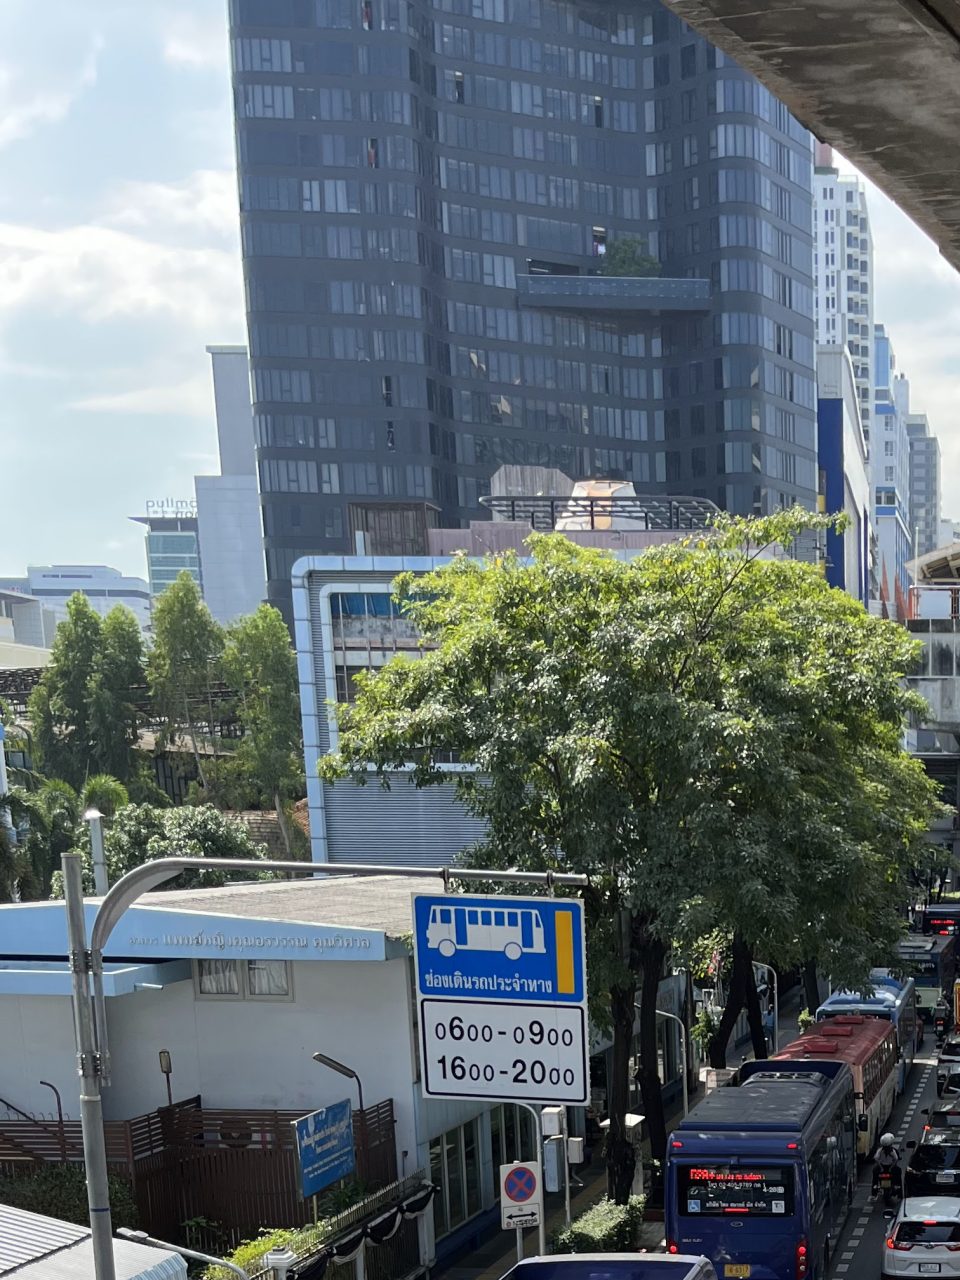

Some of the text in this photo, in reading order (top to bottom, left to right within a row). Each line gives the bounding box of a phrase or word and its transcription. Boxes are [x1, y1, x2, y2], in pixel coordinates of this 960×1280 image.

[425, 969, 552, 993] ช่องเดินรถประจำทาง
